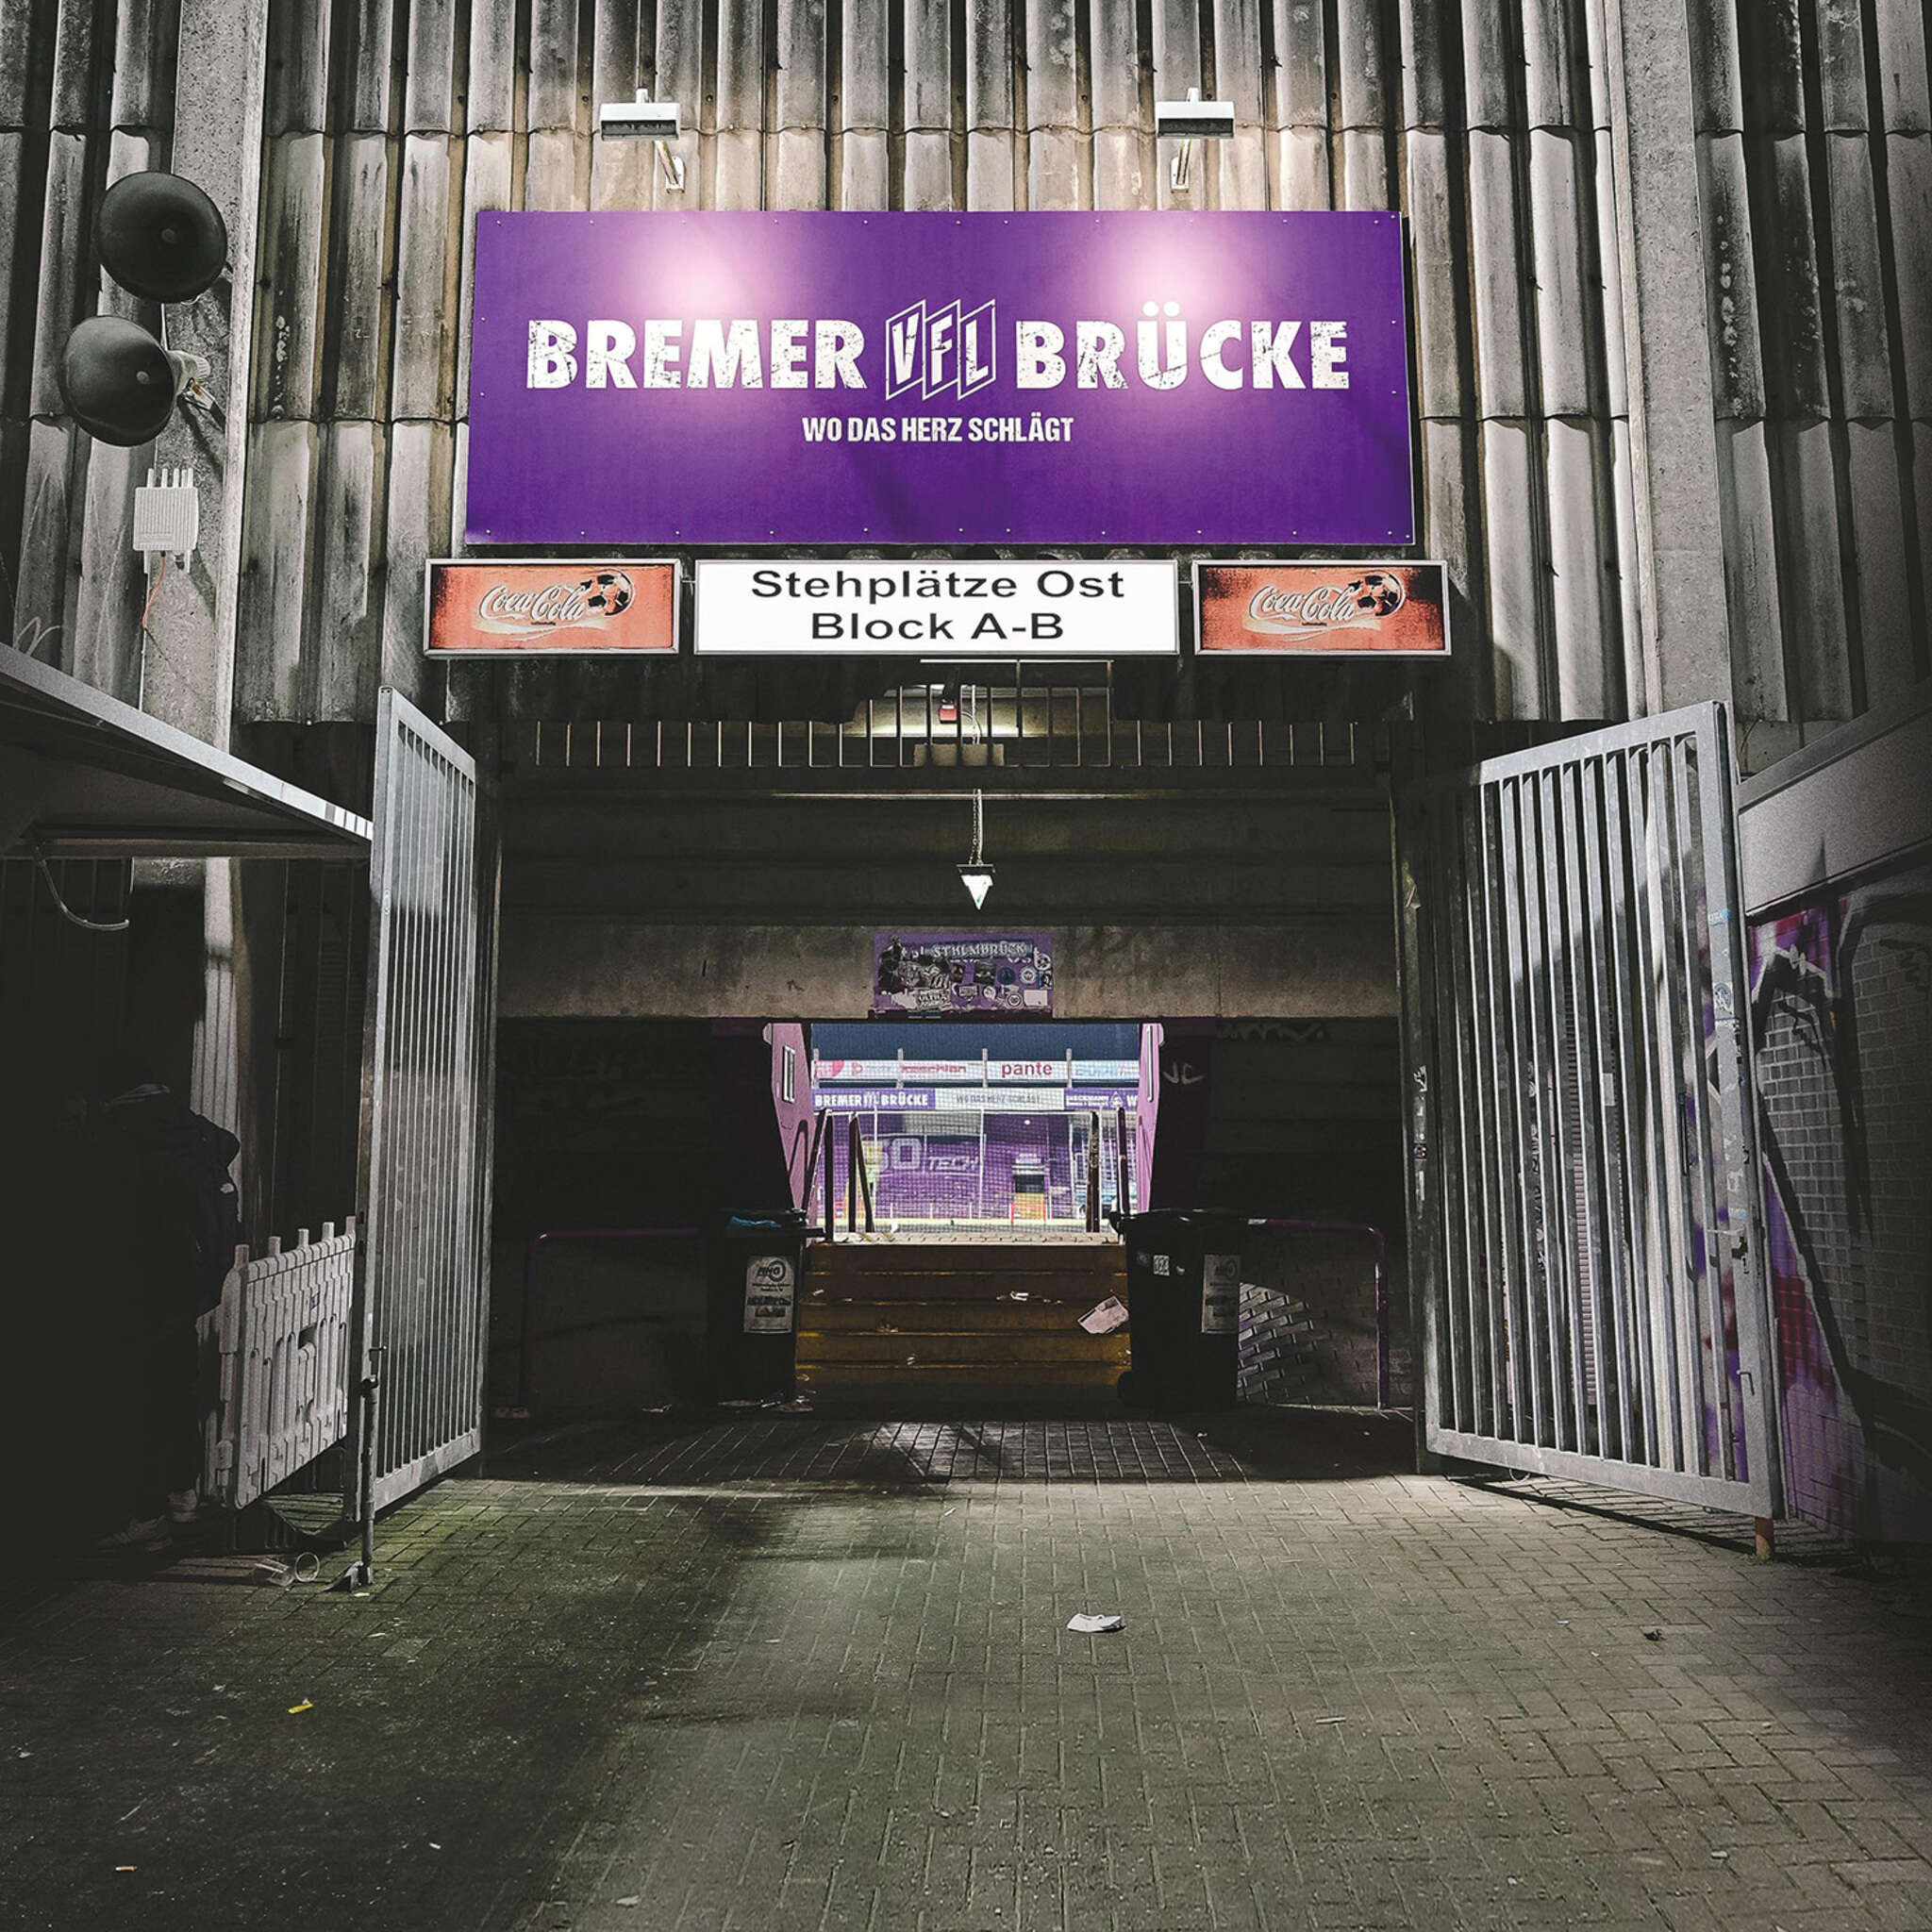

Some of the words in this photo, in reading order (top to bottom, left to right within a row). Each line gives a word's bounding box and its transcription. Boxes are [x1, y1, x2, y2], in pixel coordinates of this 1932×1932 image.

[525, 319, 868, 390] BREMER
[1015, 301, 1350, 391] BRÜCKE
[802, 417, 842, 441] WO
[848, 417, 896, 441] DAS
[901, 417, 962, 441] HERZ
[968, 411, 1074, 441] SCHLÄGT
[751, 570, 1018, 605] Stehplätze
[1037, 570, 1124, 598] Ost
[811, 612, 955, 640] Block
[971, 612, 1064, 640] A-B
[1001, 1061, 1053, 1077] pante
[815, 1094, 862, 1107] BREMER
[881, 1091, 928, 1106] BRÜCKE
